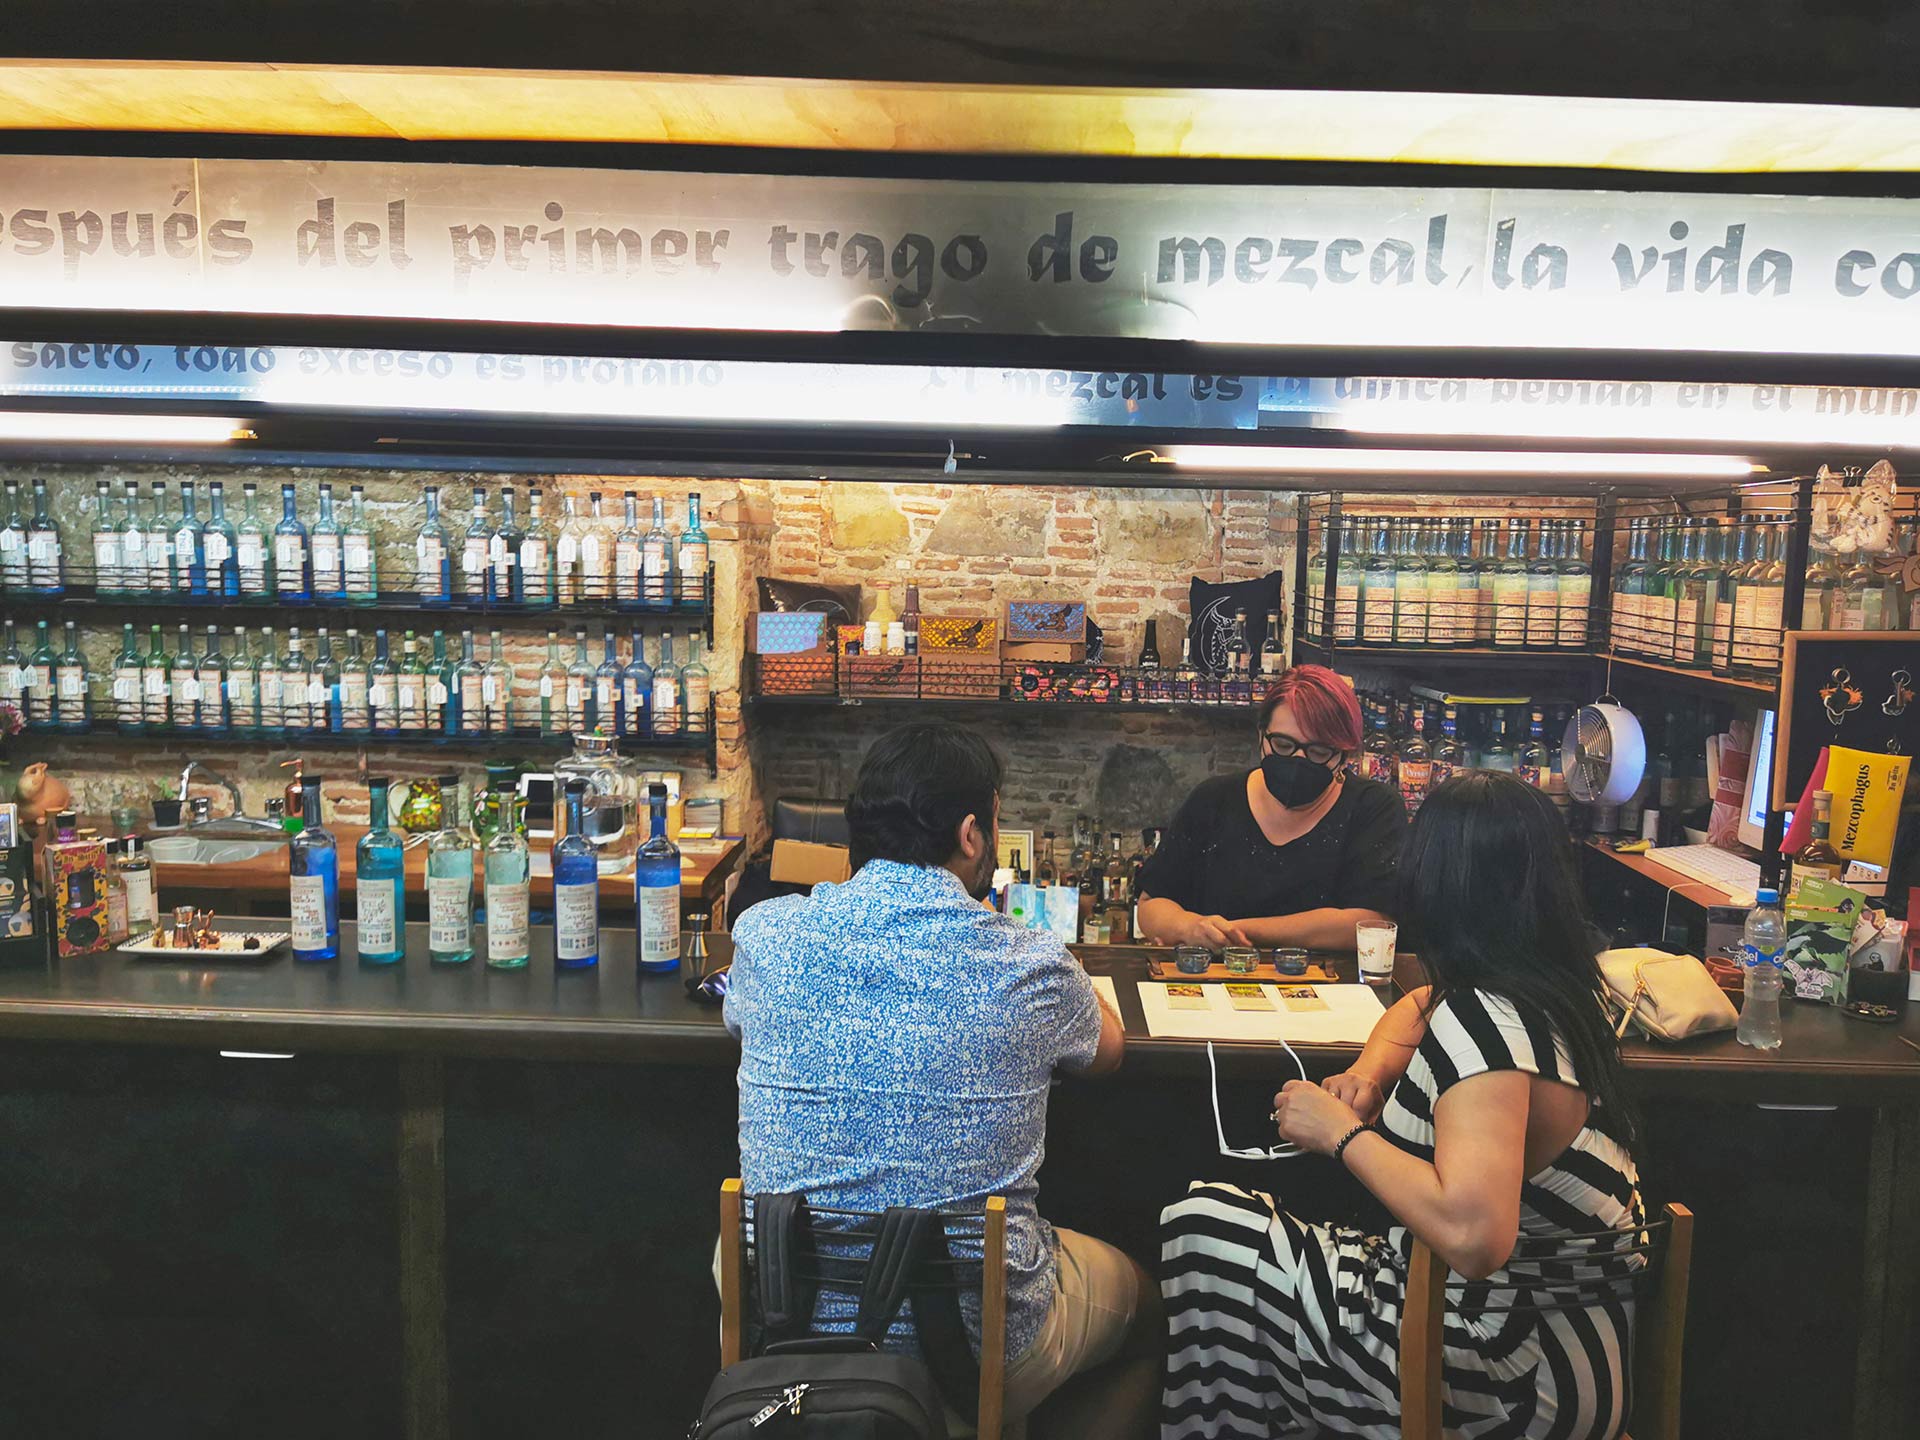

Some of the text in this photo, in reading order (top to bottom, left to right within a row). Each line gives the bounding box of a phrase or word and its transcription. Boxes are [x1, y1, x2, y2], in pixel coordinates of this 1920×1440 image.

[0, 189, 254, 282] spués
[297, 197, 413, 270] del
[449, 201, 731, 295] primer
[767, 224, 988, 308] trago
[1026, 210, 1119, 283] de
[1156, 213, 1474, 292] mezcal,
[1490, 217, 1568, 291] la
[1611, 220, 1793, 297] vida
[297, 347, 453, 379] exceso
[475, 353, 526, 382] es
[1191, 373, 1244, 401] es
[1677, 382, 1729, 411] en
[1841, 763, 1871, 852] Mezcophagus
